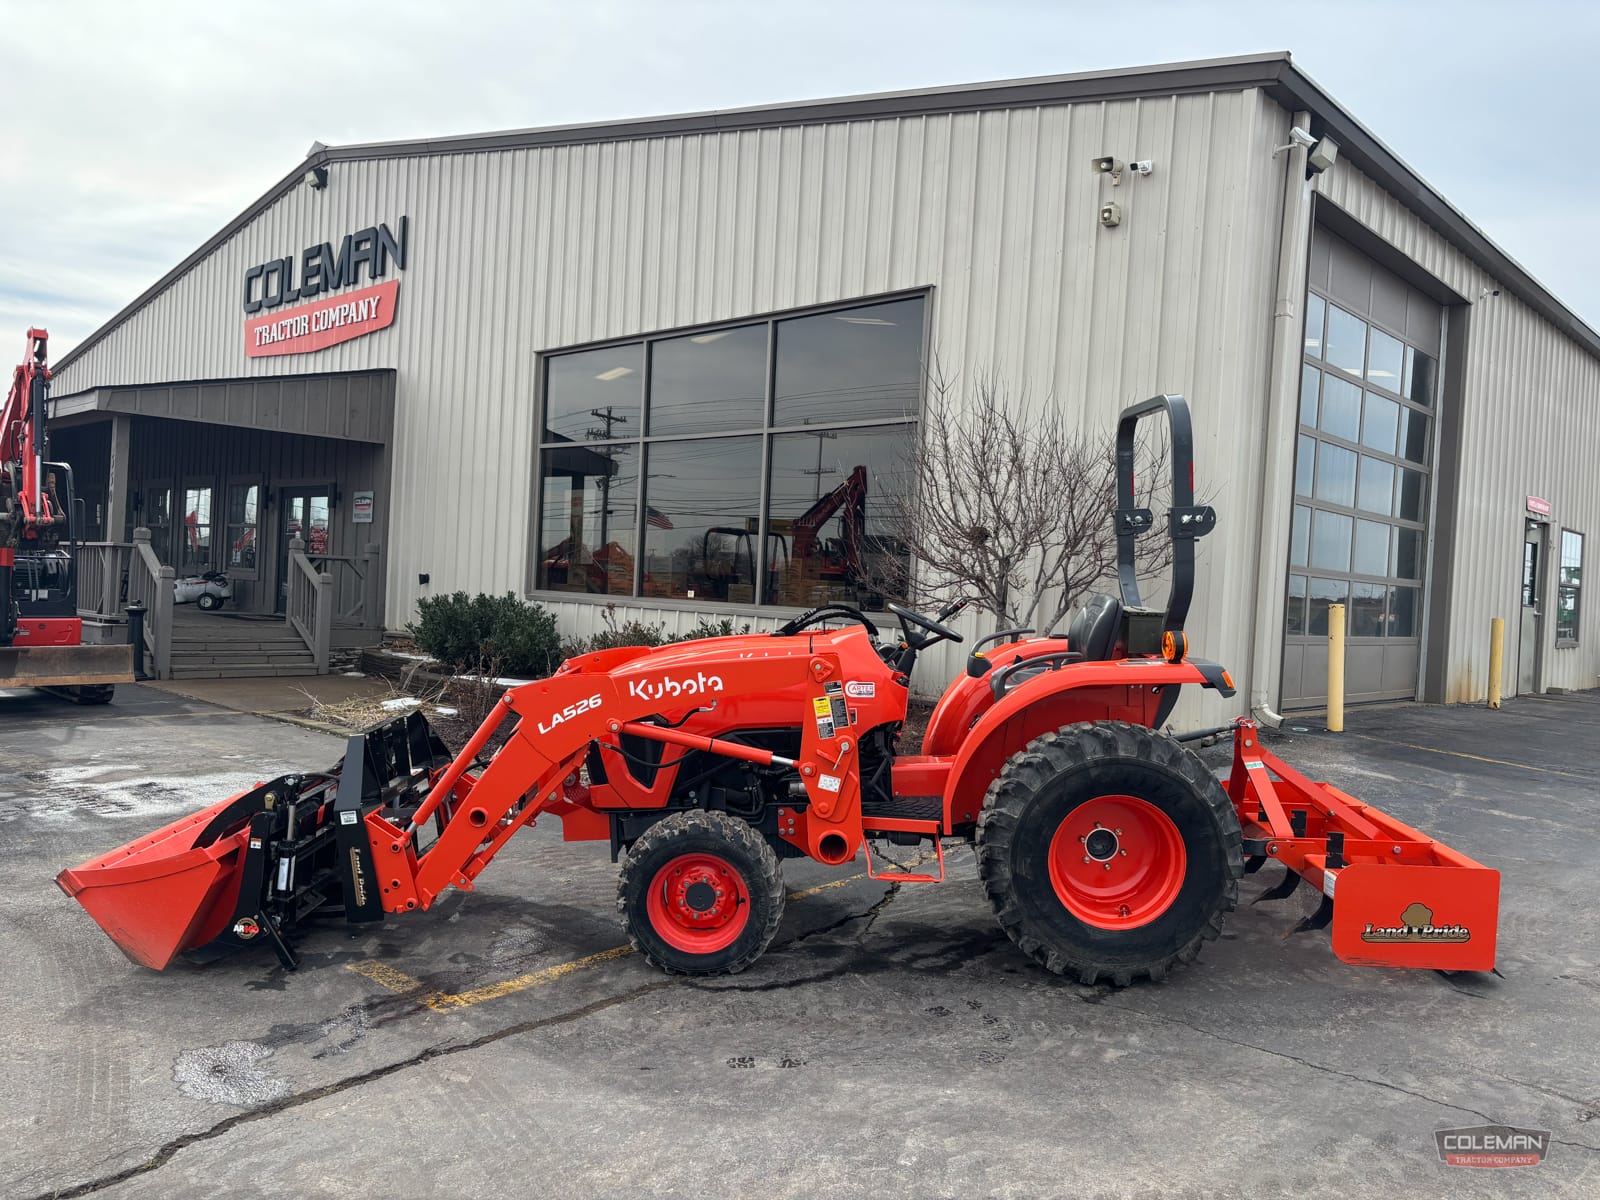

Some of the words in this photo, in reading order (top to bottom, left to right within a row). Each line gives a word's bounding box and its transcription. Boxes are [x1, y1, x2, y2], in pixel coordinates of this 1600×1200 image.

[244, 215, 407, 313] COLEMAN
[254, 314, 309, 346] TRACTOR
[312, 296, 381, 332] COMPANY
[629, 672, 723, 700] Kubota
[538, 694, 602, 734] LA526
[1363, 923, 1408, 937] Land
[1422, 924, 1468, 938] Pride
